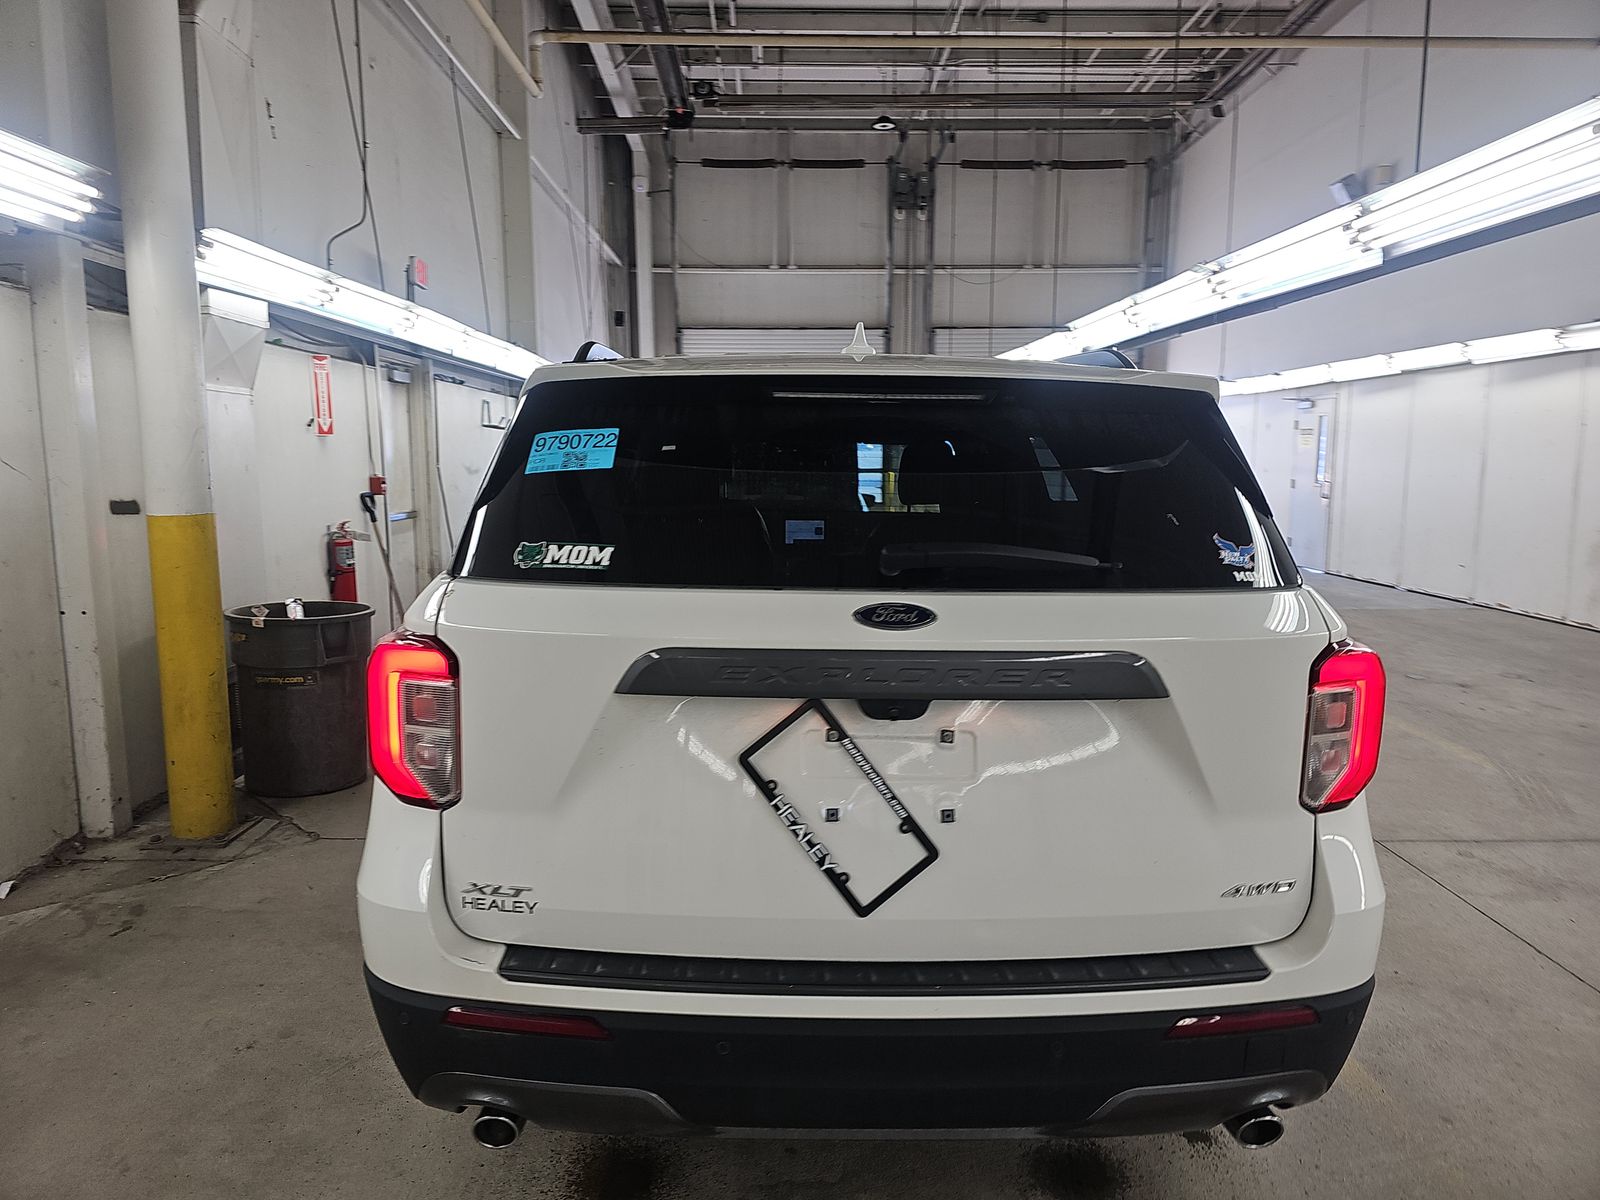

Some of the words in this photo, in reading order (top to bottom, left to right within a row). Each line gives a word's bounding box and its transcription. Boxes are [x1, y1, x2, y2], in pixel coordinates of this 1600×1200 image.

[534, 432, 618, 453] 9790722
[542, 544, 615, 566] MOM
[871, 606, 919, 622] Ford
[709, 665, 1074, 687] EXPLORER
[840, 737, 909, 819] healeybrothers.com
[769, 792, 839, 871] HEALEY
[461, 881, 533, 898] XLT
[1220, 878, 1297, 898] 4WD
[461, 896, 540, 914] HEALEY
